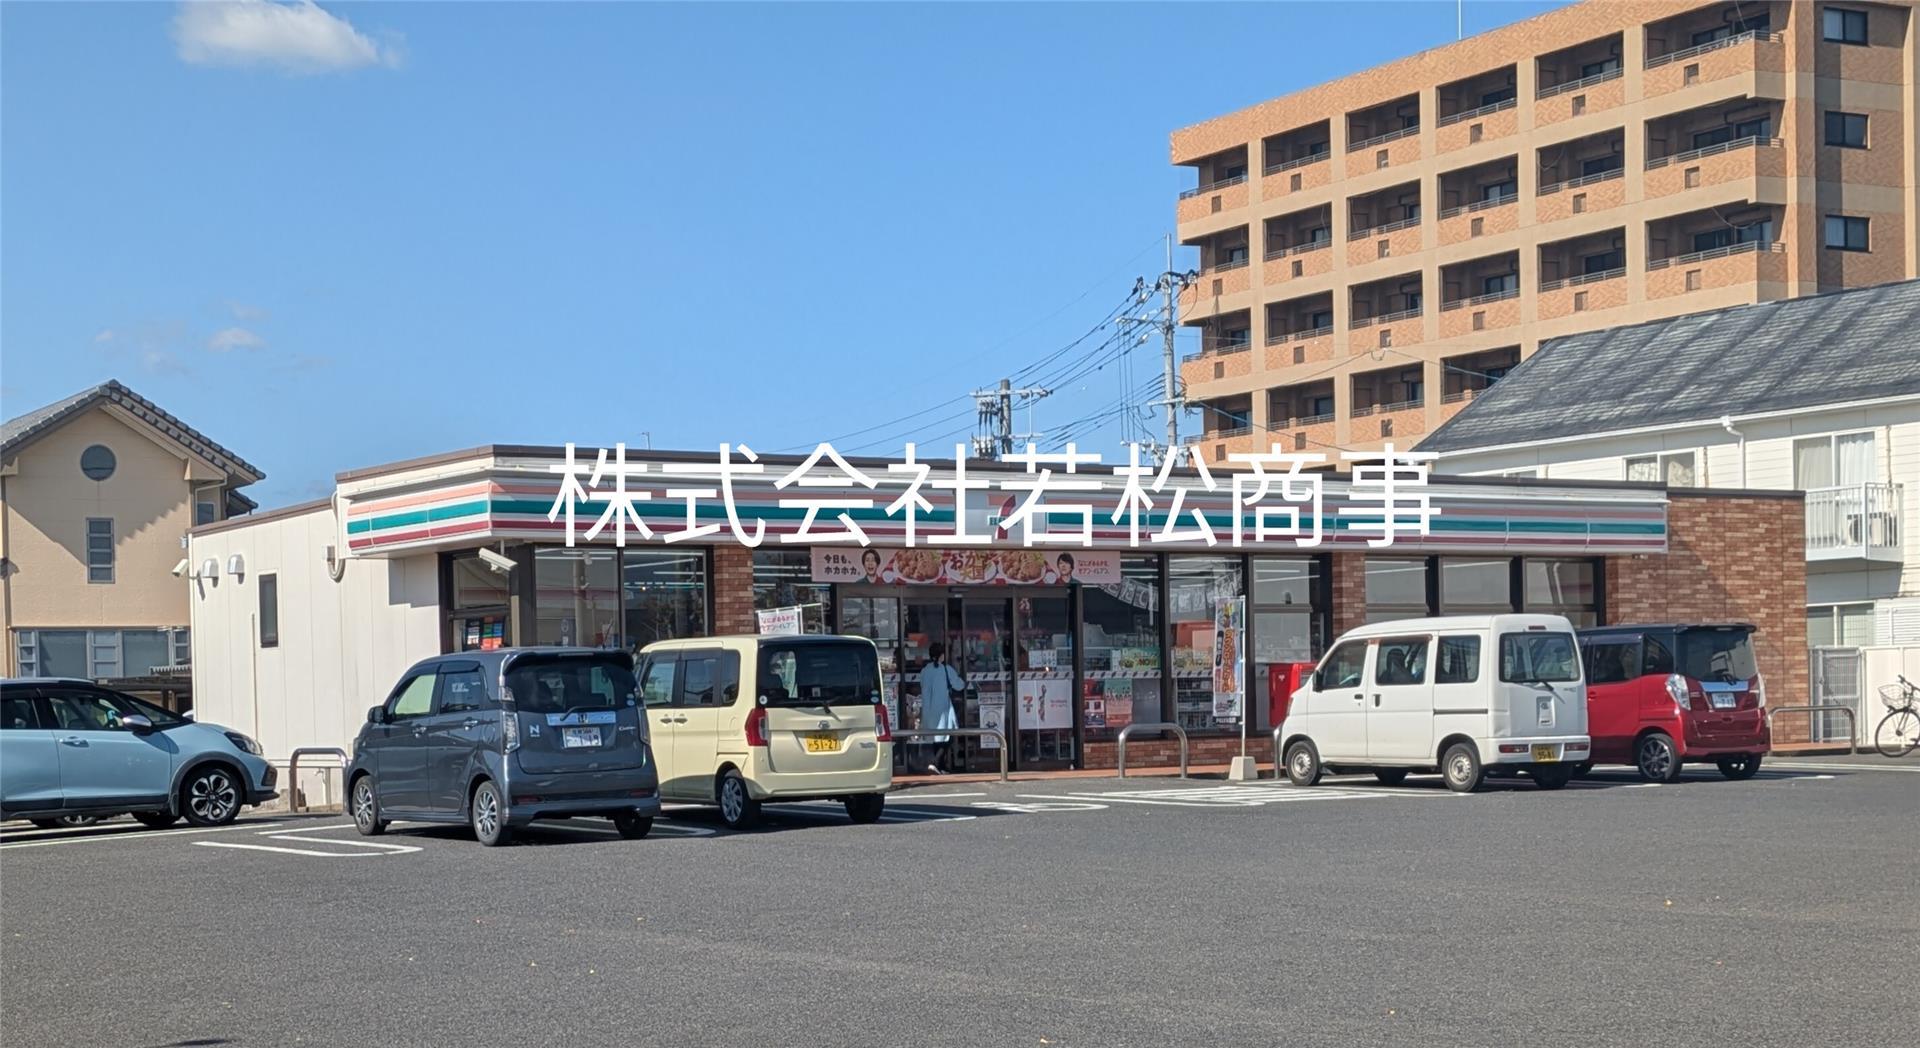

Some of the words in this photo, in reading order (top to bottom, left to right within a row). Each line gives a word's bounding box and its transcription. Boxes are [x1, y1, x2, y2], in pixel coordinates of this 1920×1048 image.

[823, 554, 852, 564] 今日も、
[824, 566, 861, 576] ホカホカ。
